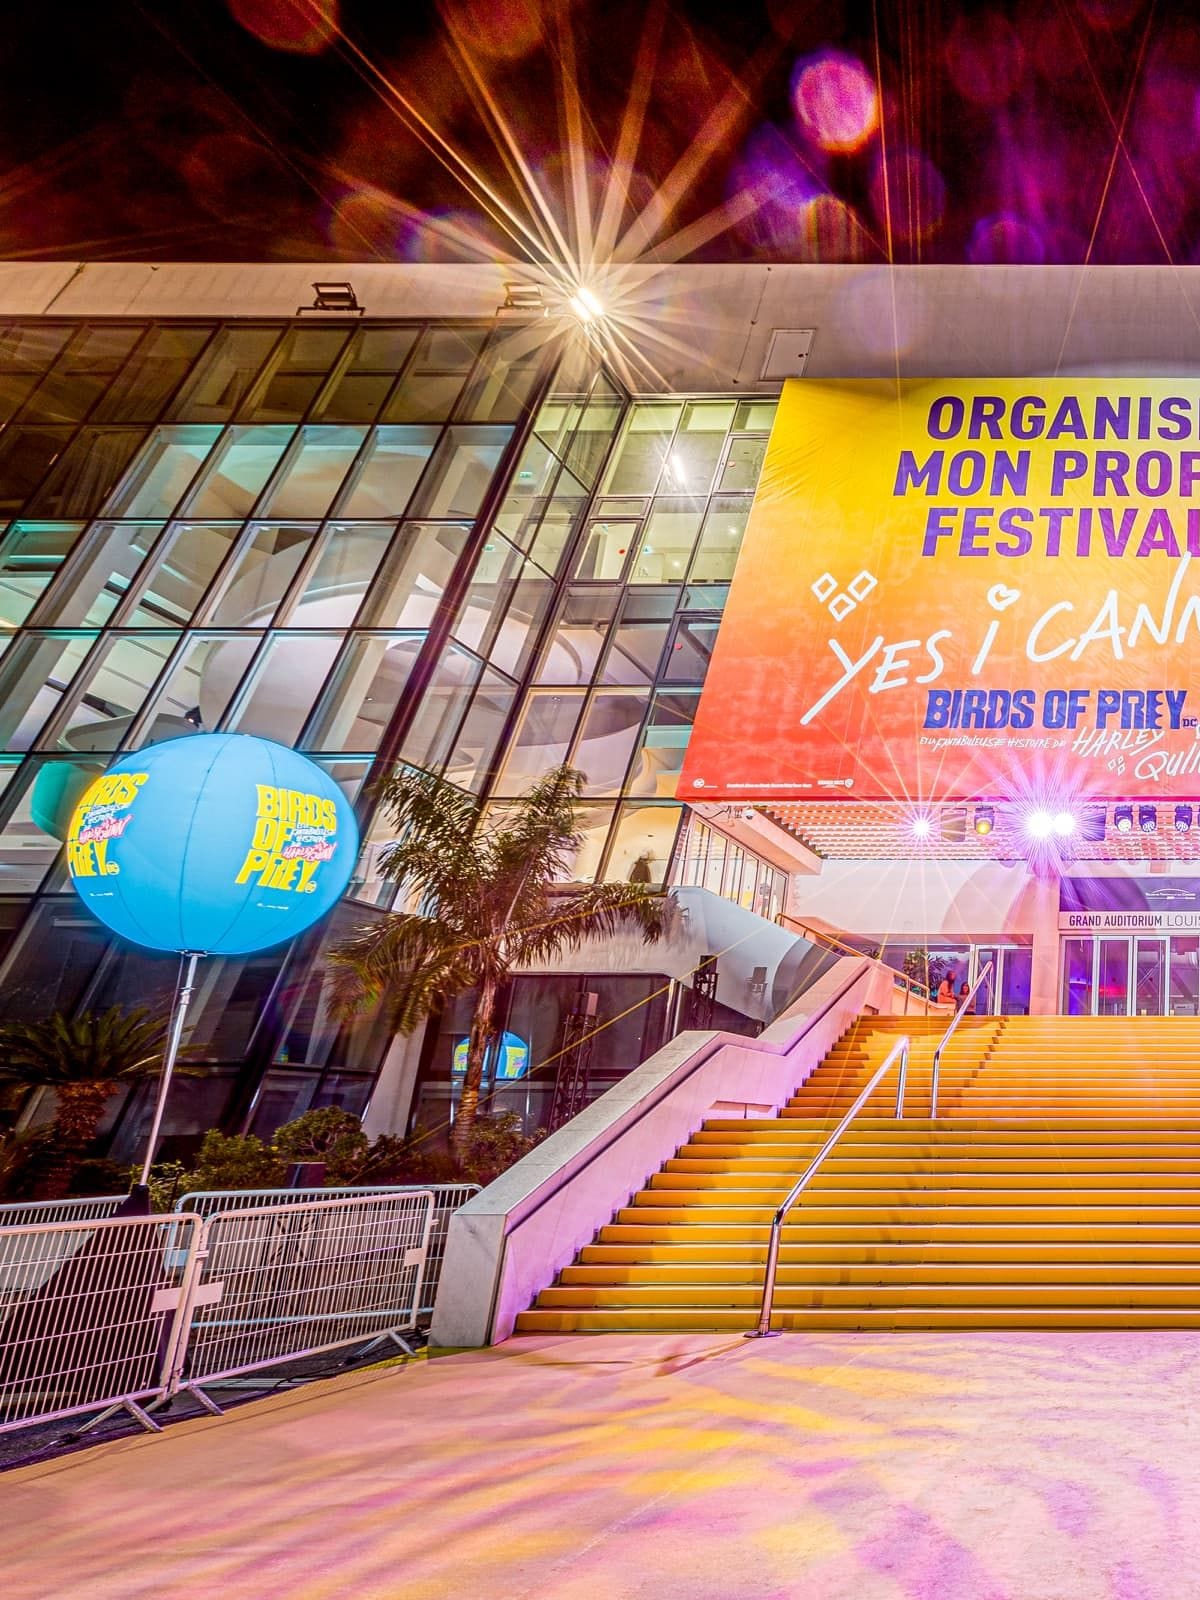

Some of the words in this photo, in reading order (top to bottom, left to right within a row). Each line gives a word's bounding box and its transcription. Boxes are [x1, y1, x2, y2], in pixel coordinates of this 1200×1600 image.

[892, 449, 1032, 497] MON
[800, 630, 952, 725] YES
[923, 689, 1036, 729] BIRDS
[1042, 689, 1090, 729] OF
[1096, 689, 1187, 730] PREY
[1182, 718, 1198, 728] DC
[1072, 727, 1166, 758] HARLEY
[255, 783, 337, 832] BIRDS
[251, 816, 297, 854] OF
[234, 848, 320, 892] PREY
[1069, 915, 1100, 927] GRAND
[1104, 915, 1162, 927] AUDITORIUM
